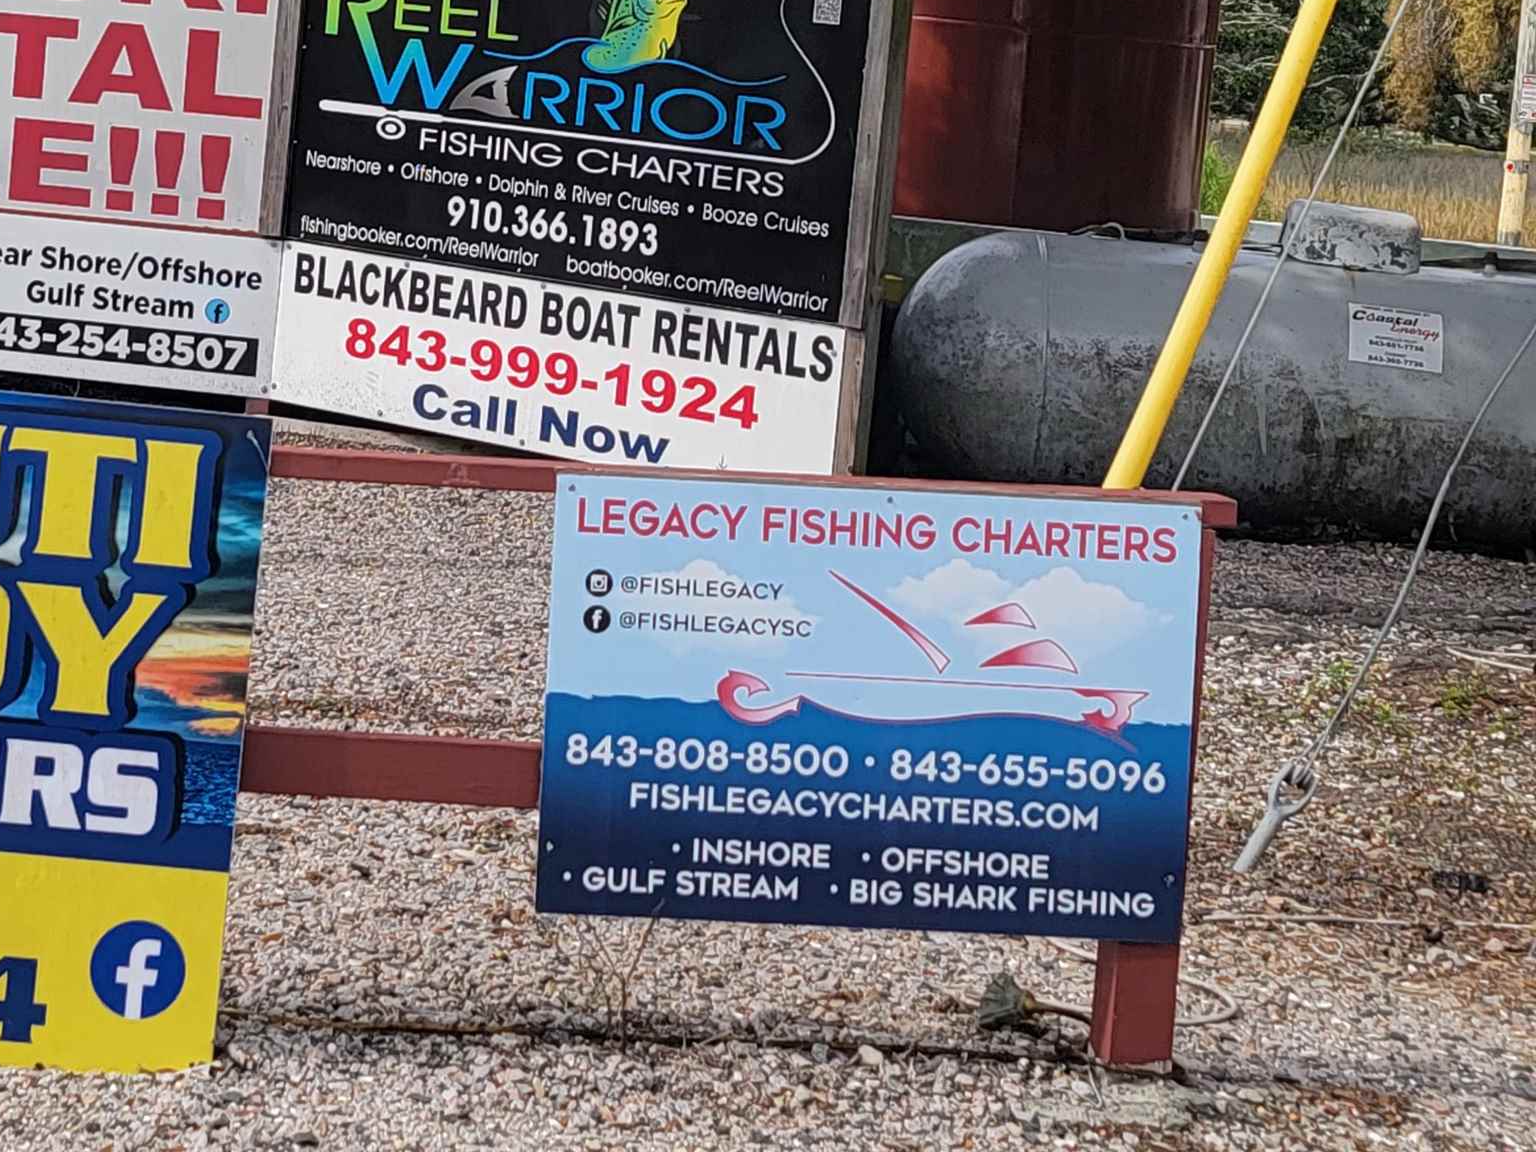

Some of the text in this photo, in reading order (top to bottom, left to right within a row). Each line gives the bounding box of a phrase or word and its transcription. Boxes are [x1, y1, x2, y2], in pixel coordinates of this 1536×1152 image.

[352, 21, 787, 151] WARRIOR
[419, 127, 784, 198] FISHING CHARTERS
[306, 150, 830, 238] Nearshore Offshore Dolphin & River Cruises Booze Cruises
[300, 215, 539, 268] fishingbooker.com/ReelWarrior
[447, 196, 658, 256] 910.366.1893
[40, 245, 263, 291] Shore/Offshore
[567, 254, 829, 314] boatbooker.com/ReelWarrior
[26, 281, 85, 309] Gulf
[94, 287, 195, 320] Stream
[293, 252, 836, 383] BLACKBEARD BOAT RENTALS
[1352, 310, 1418, 326] Coastal
[344, 318, 759, 431] 843-999-1924
[412, 382, 671, 465] Call Now
[576, 496, 1179, 565] LEGACY FISHING CHARTERS
[620, 574, 785, 601] @FISHLEGACY
[617, 610, 812, 638] @FISHLEGACYSC
[565, 733, 1166, 794] 843-808-8500 843-655-5096
[629, 781, 1100, 832] FISHLEGACYCHARTERS.COM
[692, 837, 1051, 880] INSHORE OFFSHORE
[581, 866, 1156, 918] GULF STREAM BIG SHARK FISHING
